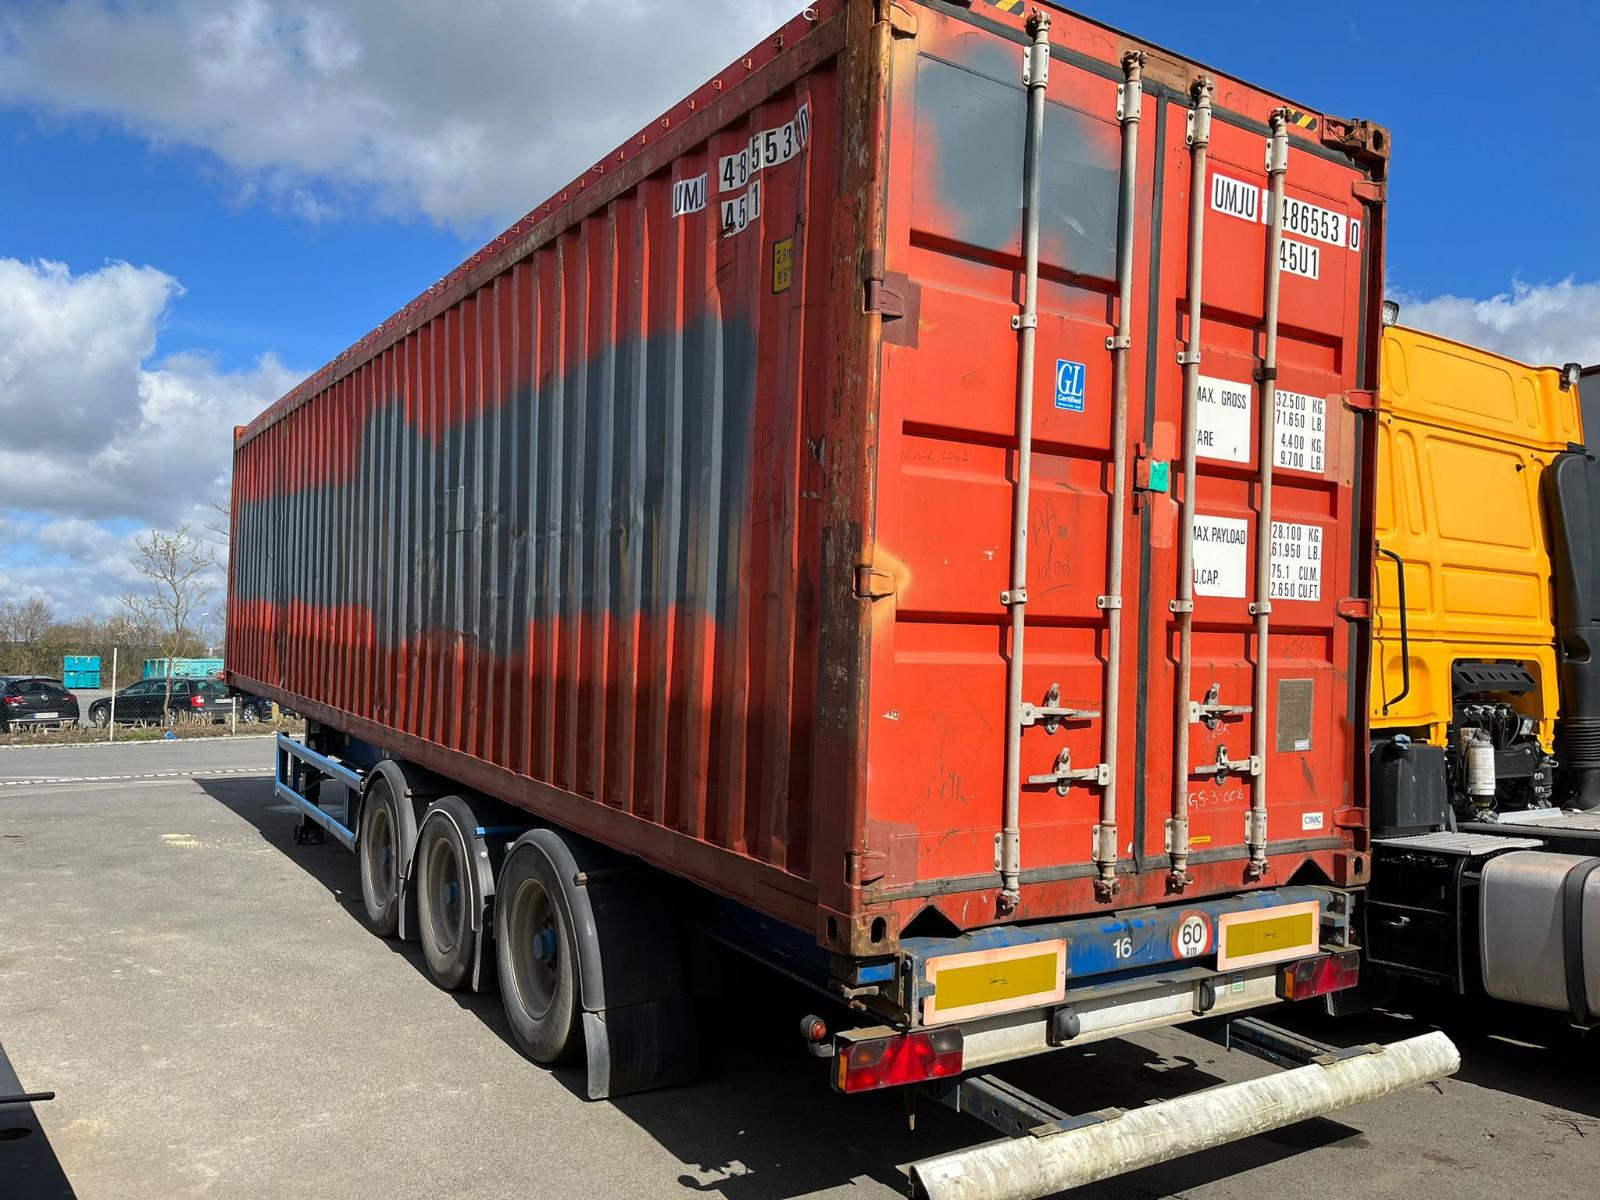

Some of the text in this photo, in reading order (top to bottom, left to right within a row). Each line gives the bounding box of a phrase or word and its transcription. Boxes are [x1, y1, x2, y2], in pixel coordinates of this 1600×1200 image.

[1214, 177, 1257, 218] UMJU
[1281, 198, 1340, 243] 486553
[1279, 240, 1318, 278] 45U1
[1058, 363, 1083, 396] GL
[1057, 394, 1082, 405] Certified
[1221, 390, 1247, 410] GROSS
[1276, 391, 1306, 411] 32.500
[1312, 399, 1325, 415] KG.
[1275, 409, 1324, 433] 71.650 LB.
[1196, 429, 1324, 454] ARE 4.400 KG.
[1280, 450, 1324, 471] 9.700 LB.
[1272, 524, 1302, 541] 28.100
[1308, 528, 1321, 544] KG.
[1271, 542, 1320, 561] 61.950 LB.
[1193, 568, 1221, 585] U.CAP.
[1271, 563, 1290, 580] 75.1
[1270, 582, 1296, 598] 2.650
[1304, 815, 1322, 825] CIMC
[1182, 923, 1203, 945] 60
[1113, 937, 1133, 959] 16
[1185, 946, 1198, 956] km
